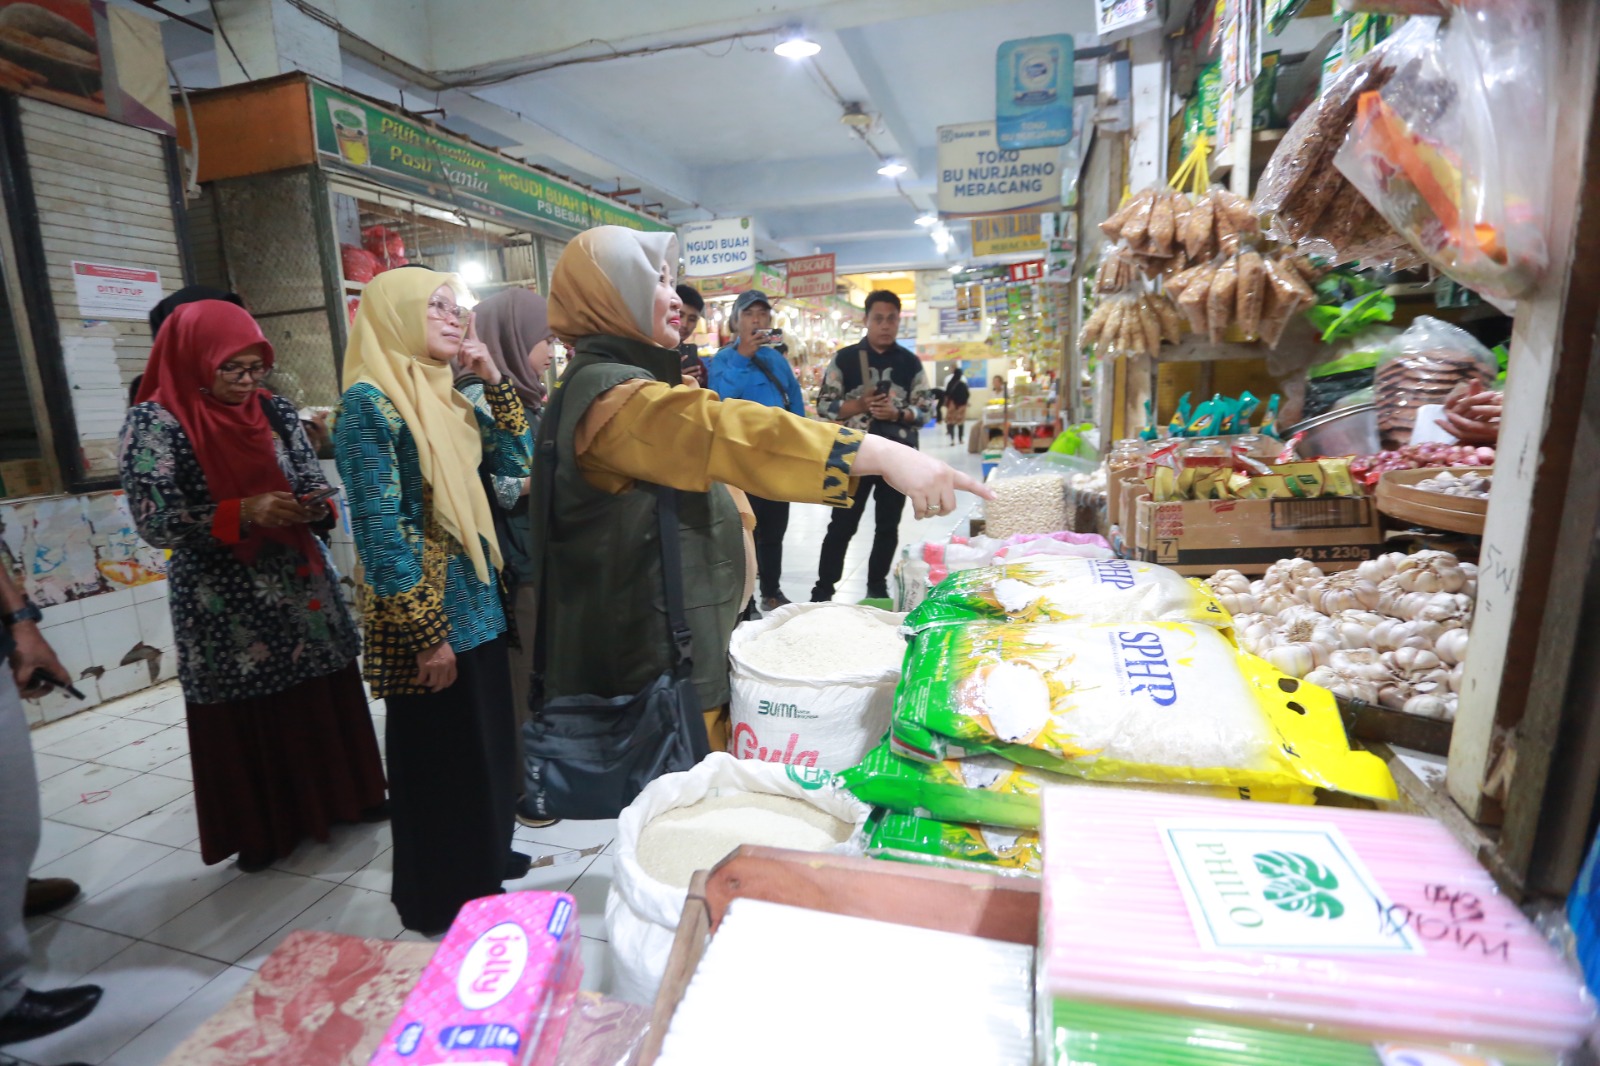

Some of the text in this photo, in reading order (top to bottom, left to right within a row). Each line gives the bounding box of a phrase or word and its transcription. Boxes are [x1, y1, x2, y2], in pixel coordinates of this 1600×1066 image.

[381, 117, 421, 146] Pilih
[976, 150, 1020, 164] TOKO
[390, 145, 489, 194] Pasti Sania
[942, 162, 1055, 183] BU NURJARNO
[954, 178, 1043, 197] MERACANG
[537, 200, 552, 215] PS
[686, 236, 749, 252] NGUDI BUAH
[690, 251, 747, 265] PAK SYONO
[97, 285, 144, 296] DITUTUP
[1161, 540, 1172, 556] 7
[1294, 547, 1314, 559] 24
[1331, 546, 1371, 560] 230g
[1118, 631, 1177, 706] SPHP
[1195, 842, 1264, 929] PHILO
[472, 933, 522, 993] jolly
